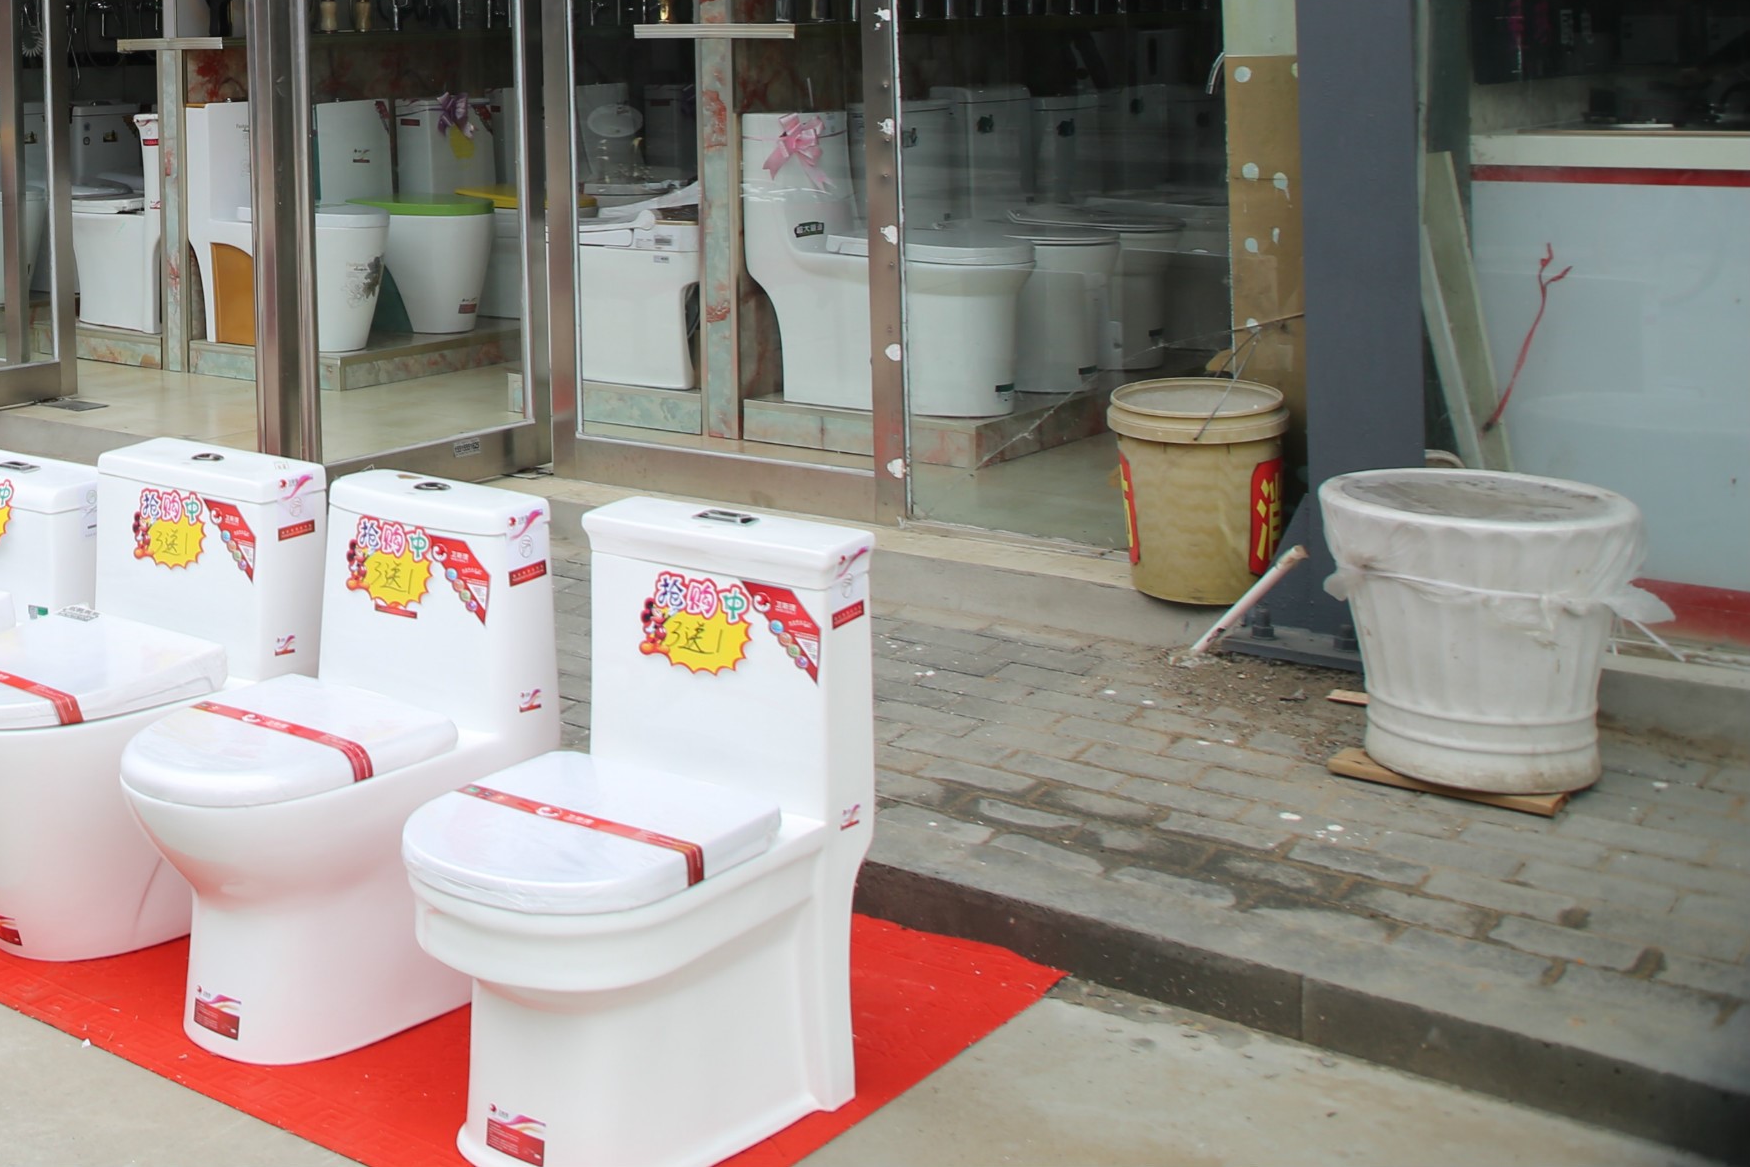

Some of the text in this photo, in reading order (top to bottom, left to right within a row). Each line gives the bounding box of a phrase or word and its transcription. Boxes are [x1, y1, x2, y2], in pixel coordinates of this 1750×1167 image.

[141, 492, 200, 523] 抢购中
[358, 520, 428, 559] 抢购中
[657, 577, 746, 621] 抢购中
